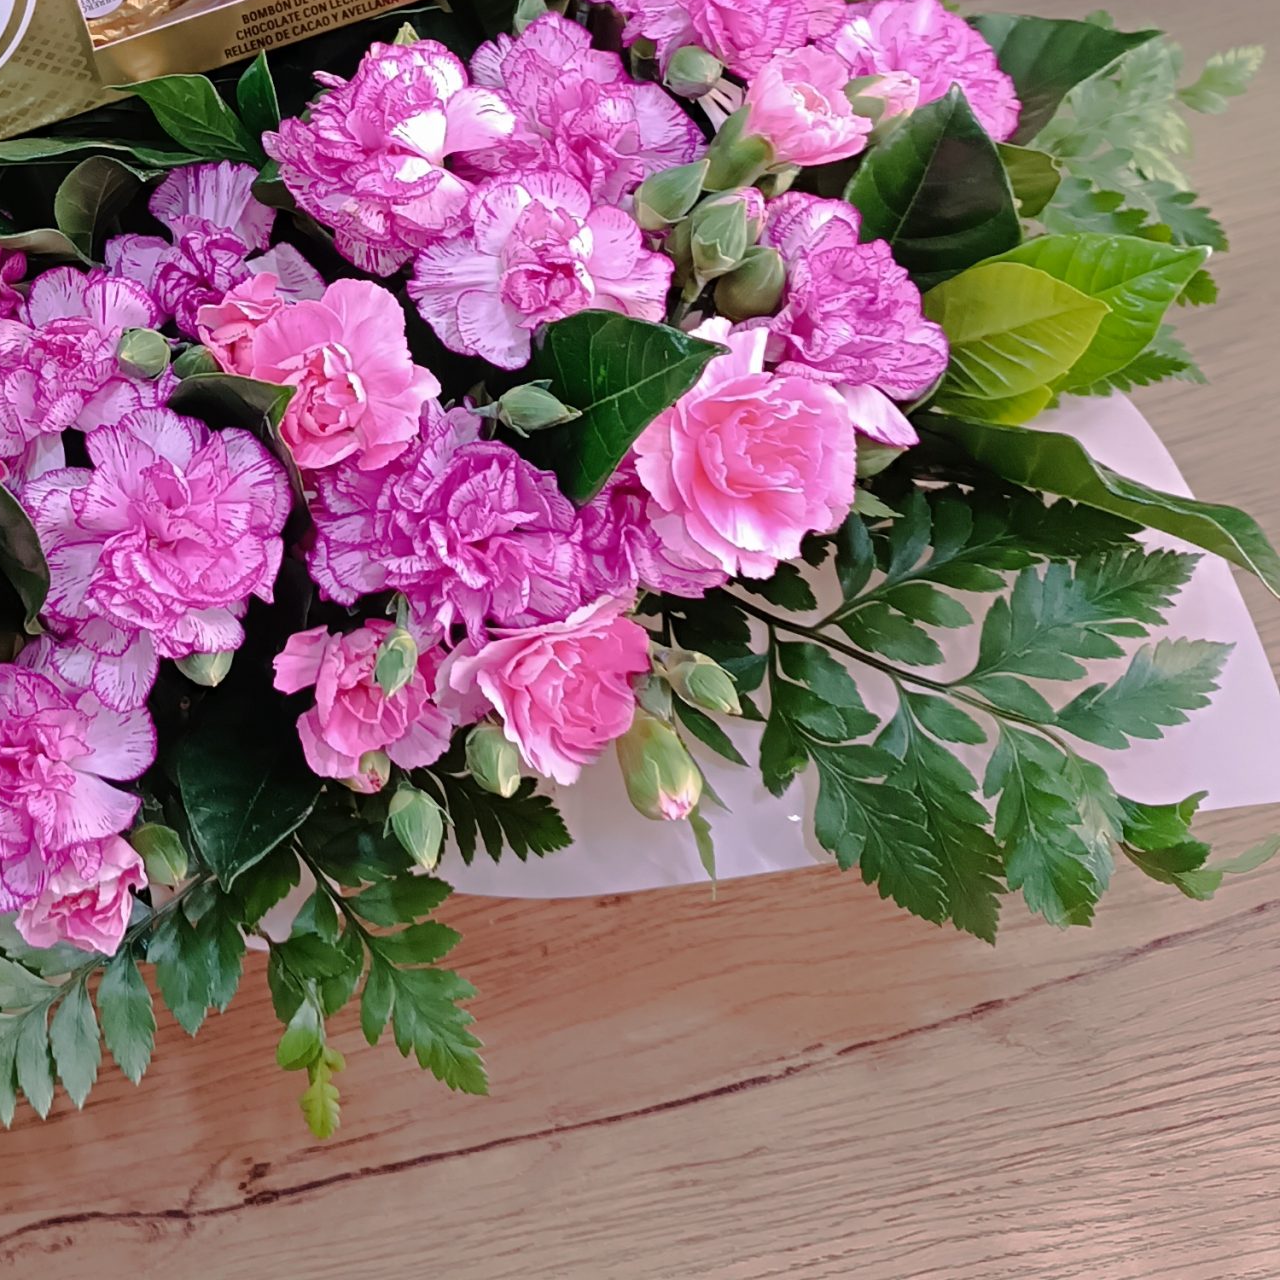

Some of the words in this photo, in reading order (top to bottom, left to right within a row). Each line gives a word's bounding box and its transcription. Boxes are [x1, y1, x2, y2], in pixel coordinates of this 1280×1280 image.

[235, 13, 302, 42] CHOCOLATE
[303, 4, 328, 20] CON
[241, 0, 292, 24] BOMBÓN
[224, 34, 274, 59] RELLENO
[276, 29, 290, 42] DE
[292, 16, 330, 38] CACAO
[331, 11, 341, 24] Y
